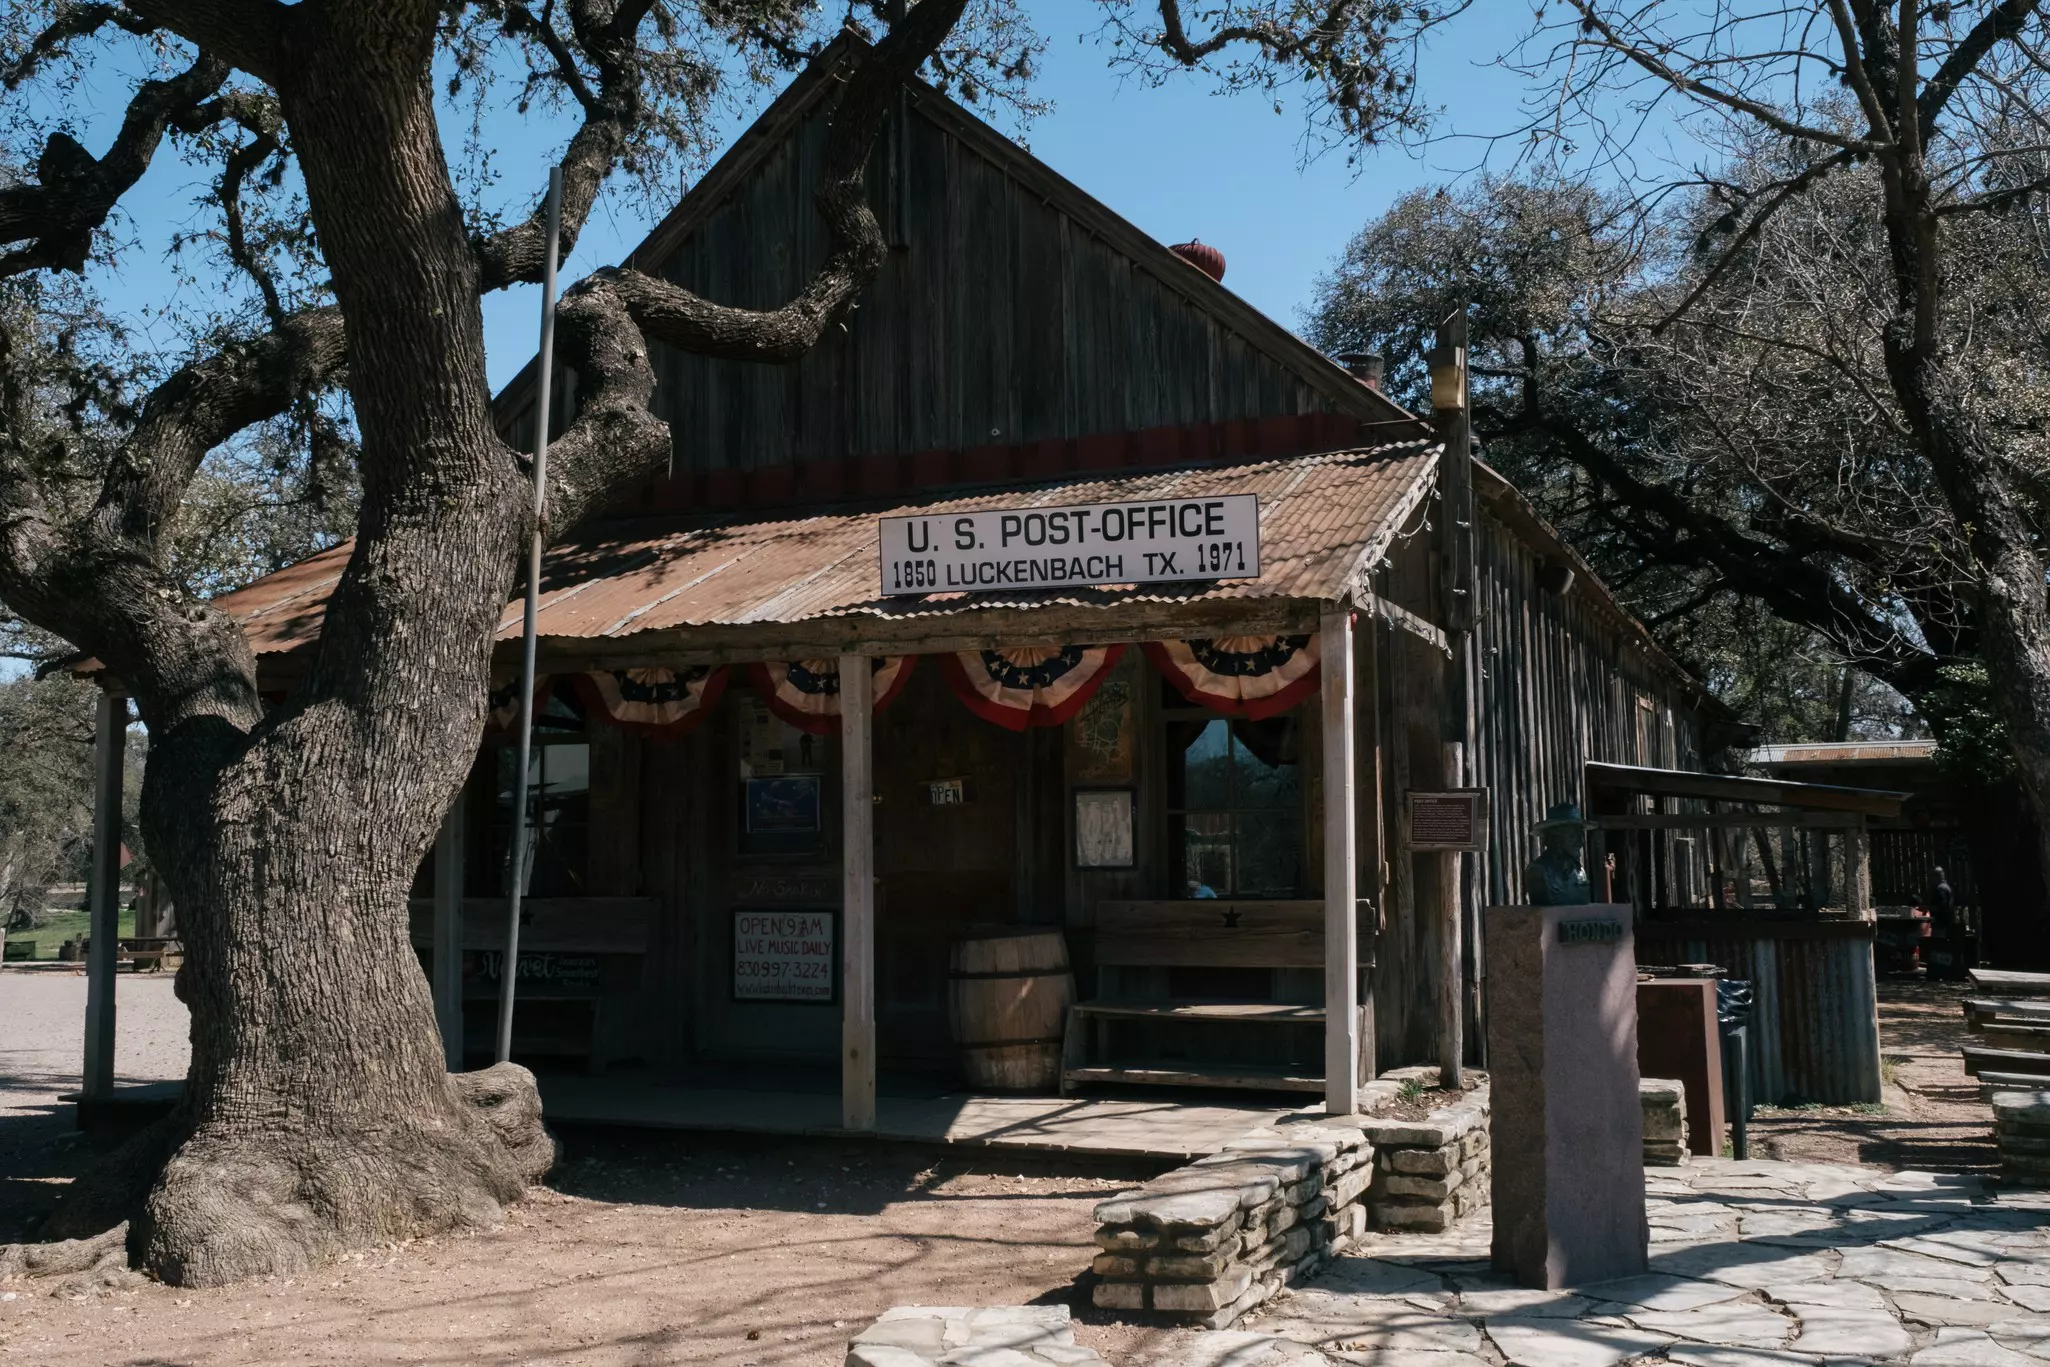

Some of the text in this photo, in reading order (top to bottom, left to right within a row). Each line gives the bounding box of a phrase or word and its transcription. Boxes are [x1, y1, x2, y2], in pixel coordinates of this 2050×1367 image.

[907, 502, 1225, 553] U. S. POST-OFFICE
[893, 541, 1246, 589] 1850 LUCKENBACH TX. 1971
[740, 917, 782, 936] OPEN
[1567, 922, 1622, 940] HONDO
[737, 939, 831, 956] LIVE MUSIC DAILY
